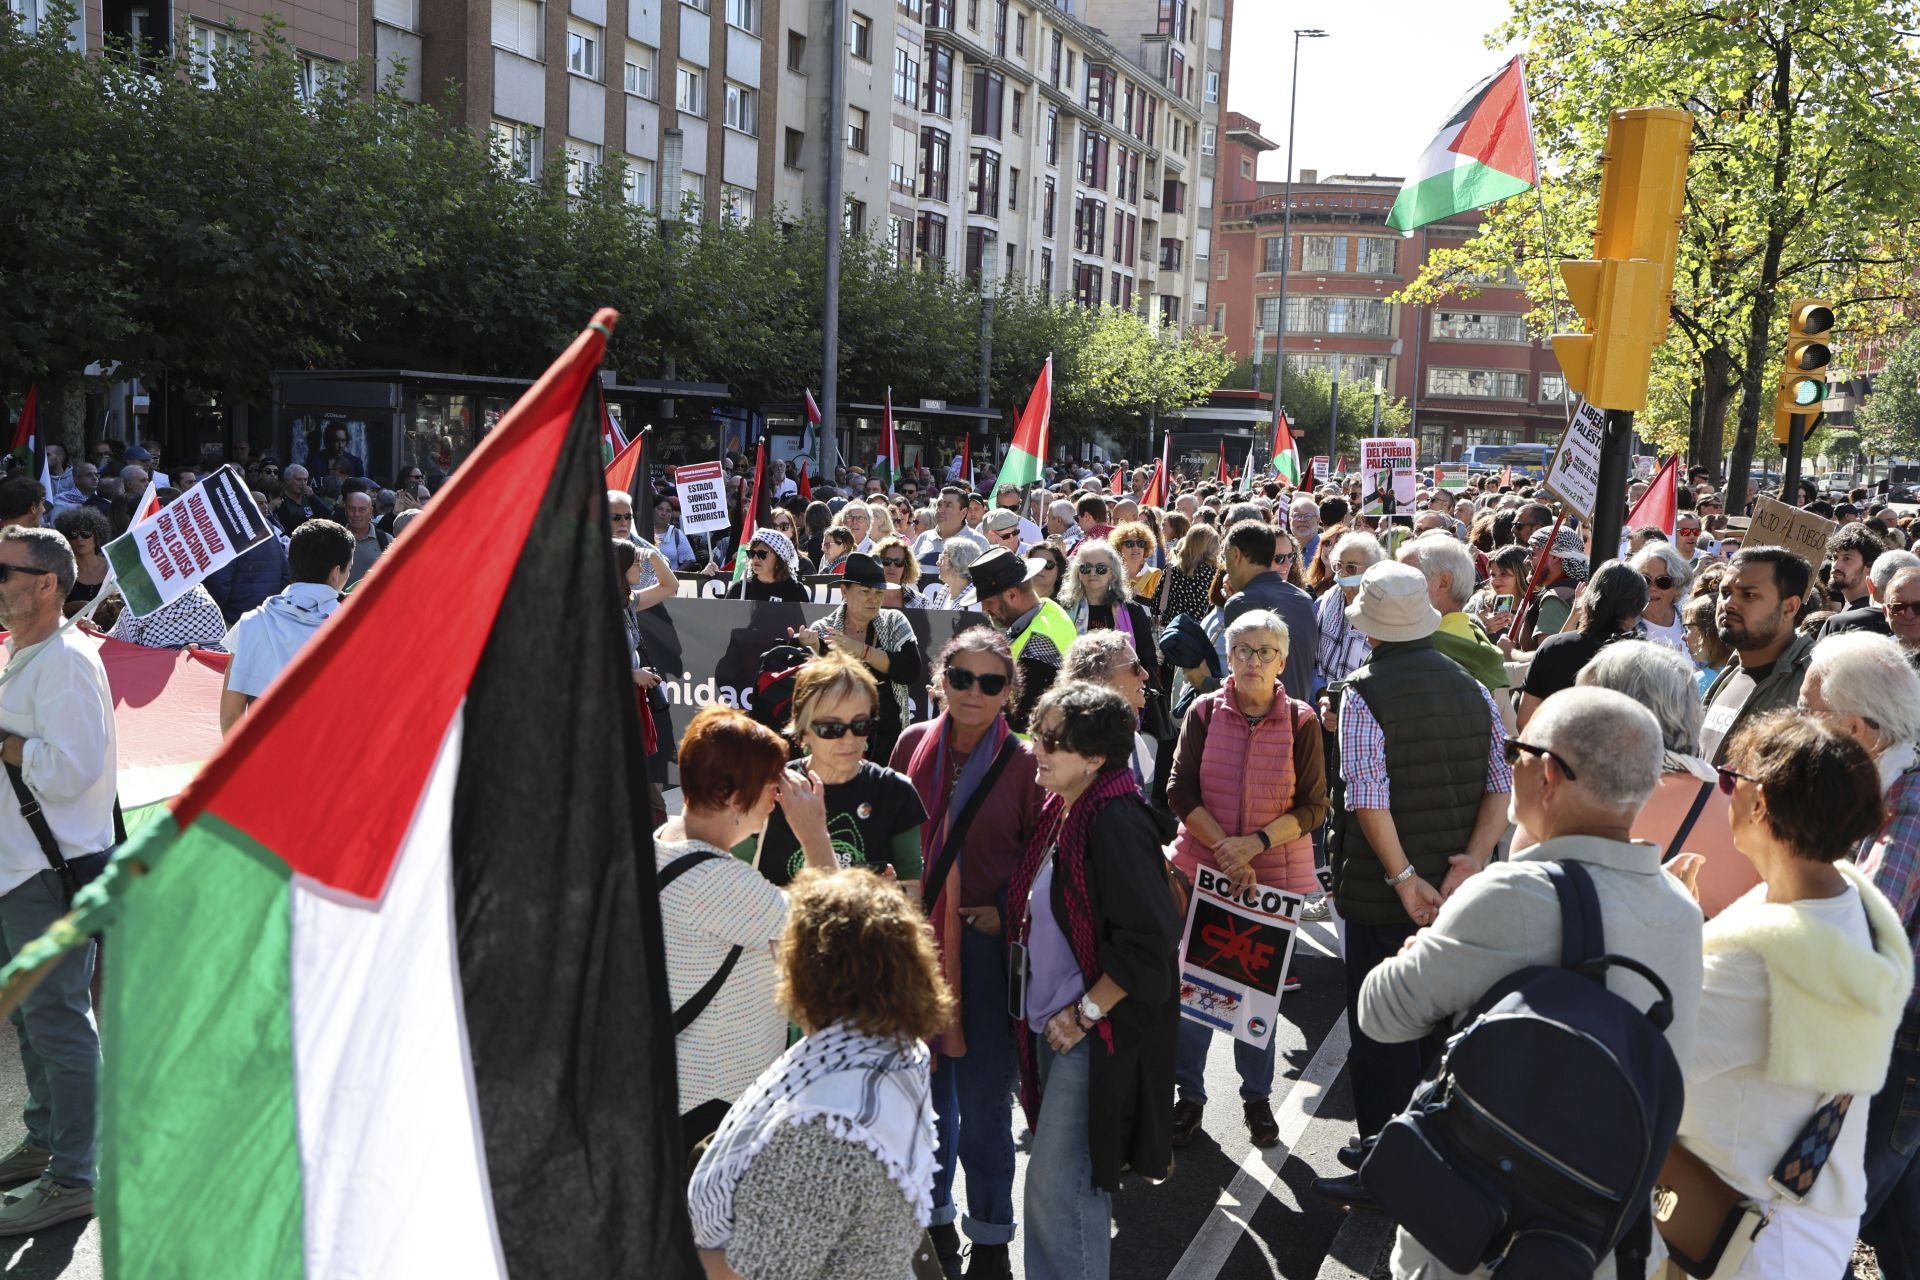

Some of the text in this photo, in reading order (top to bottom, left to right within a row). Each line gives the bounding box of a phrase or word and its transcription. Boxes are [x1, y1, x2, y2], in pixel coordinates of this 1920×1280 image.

[1367, 447, 1411, 457] DEL PUEBLO
[1180, 455, 1211, 465] Freshly
[1367, 458, 1412, 469] PALESTINO
[688, 482, 713, 493] ESTADO
[687, 492, 718, 503] SIONISTA
[691, 502, 717, 513] ESTADO
[686, 511, 725, 523] TERRORISTA
[1755, 508, 1780, 532] ALTO
[187, 492, 225, 555] SOLIDARIDAD
[172, 500, 212, 573] INTERNACIONAL
[157, 513, 195, 579] CON LA CAUSA
[145, 530, 176, 581] PALESTINA
[1199, 868, 1300, 918] BOCOT
